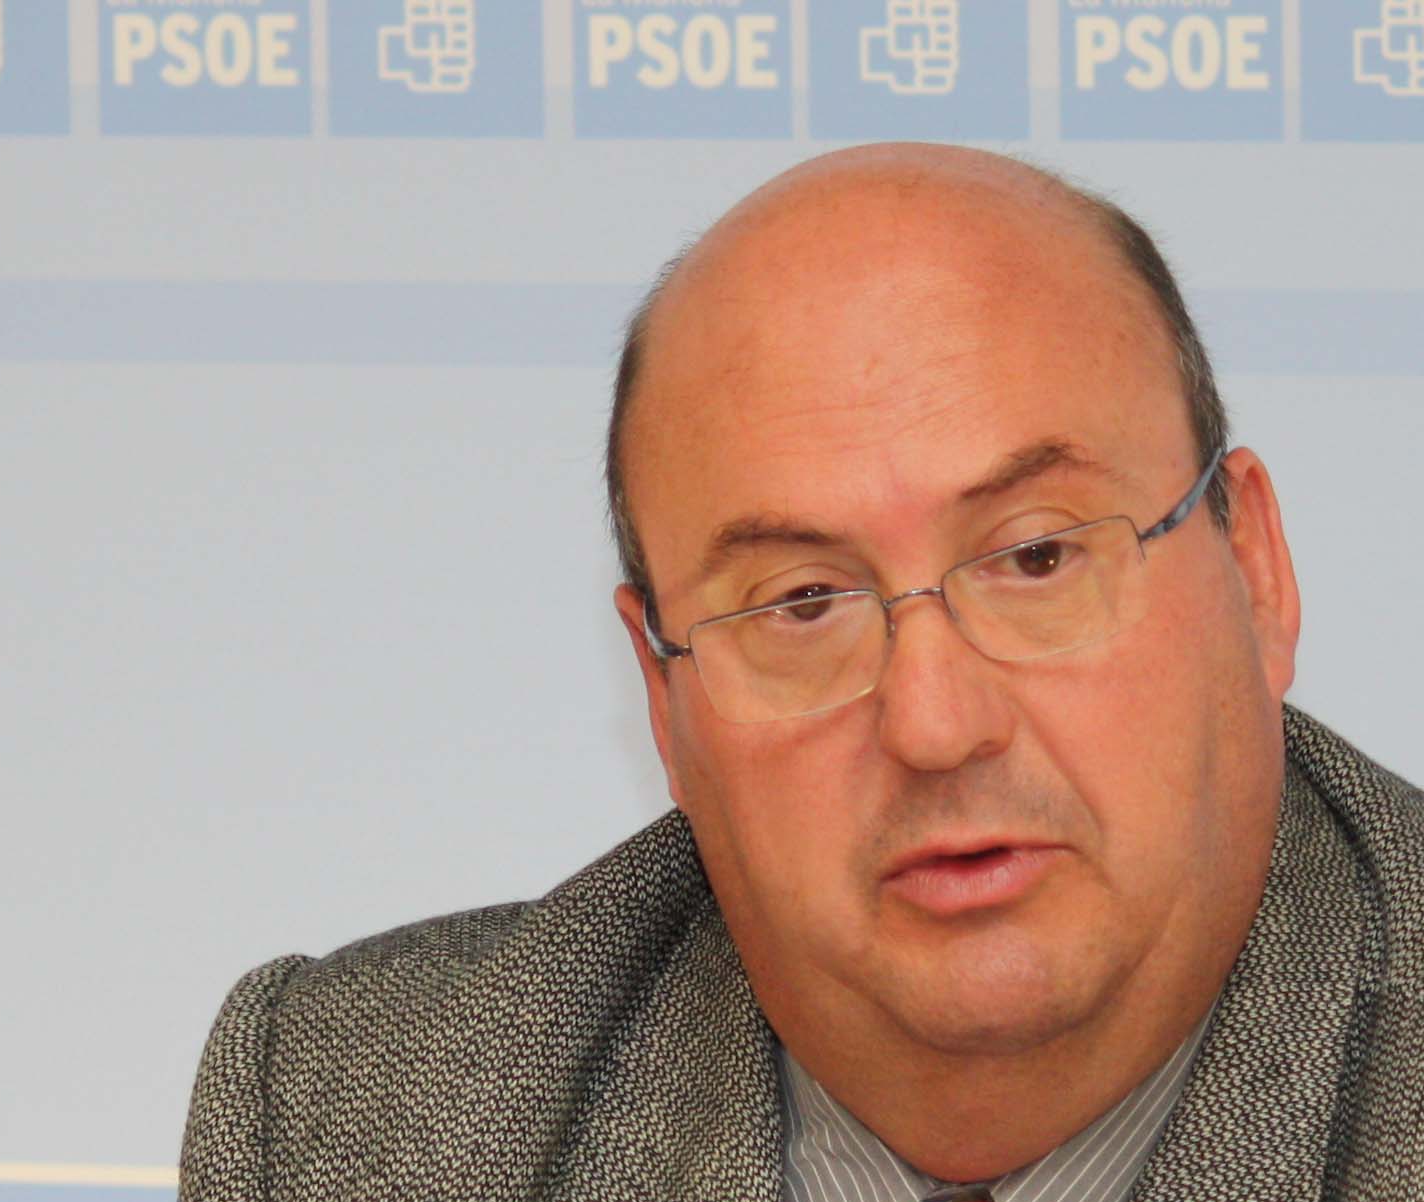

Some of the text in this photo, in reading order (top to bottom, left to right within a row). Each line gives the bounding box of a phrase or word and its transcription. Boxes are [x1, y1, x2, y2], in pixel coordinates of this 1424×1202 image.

[115, 13, 297, 86] PSOE
[590, 15, 778, 88] PSOE
[1075, 16, 1269, 90] PSOE
